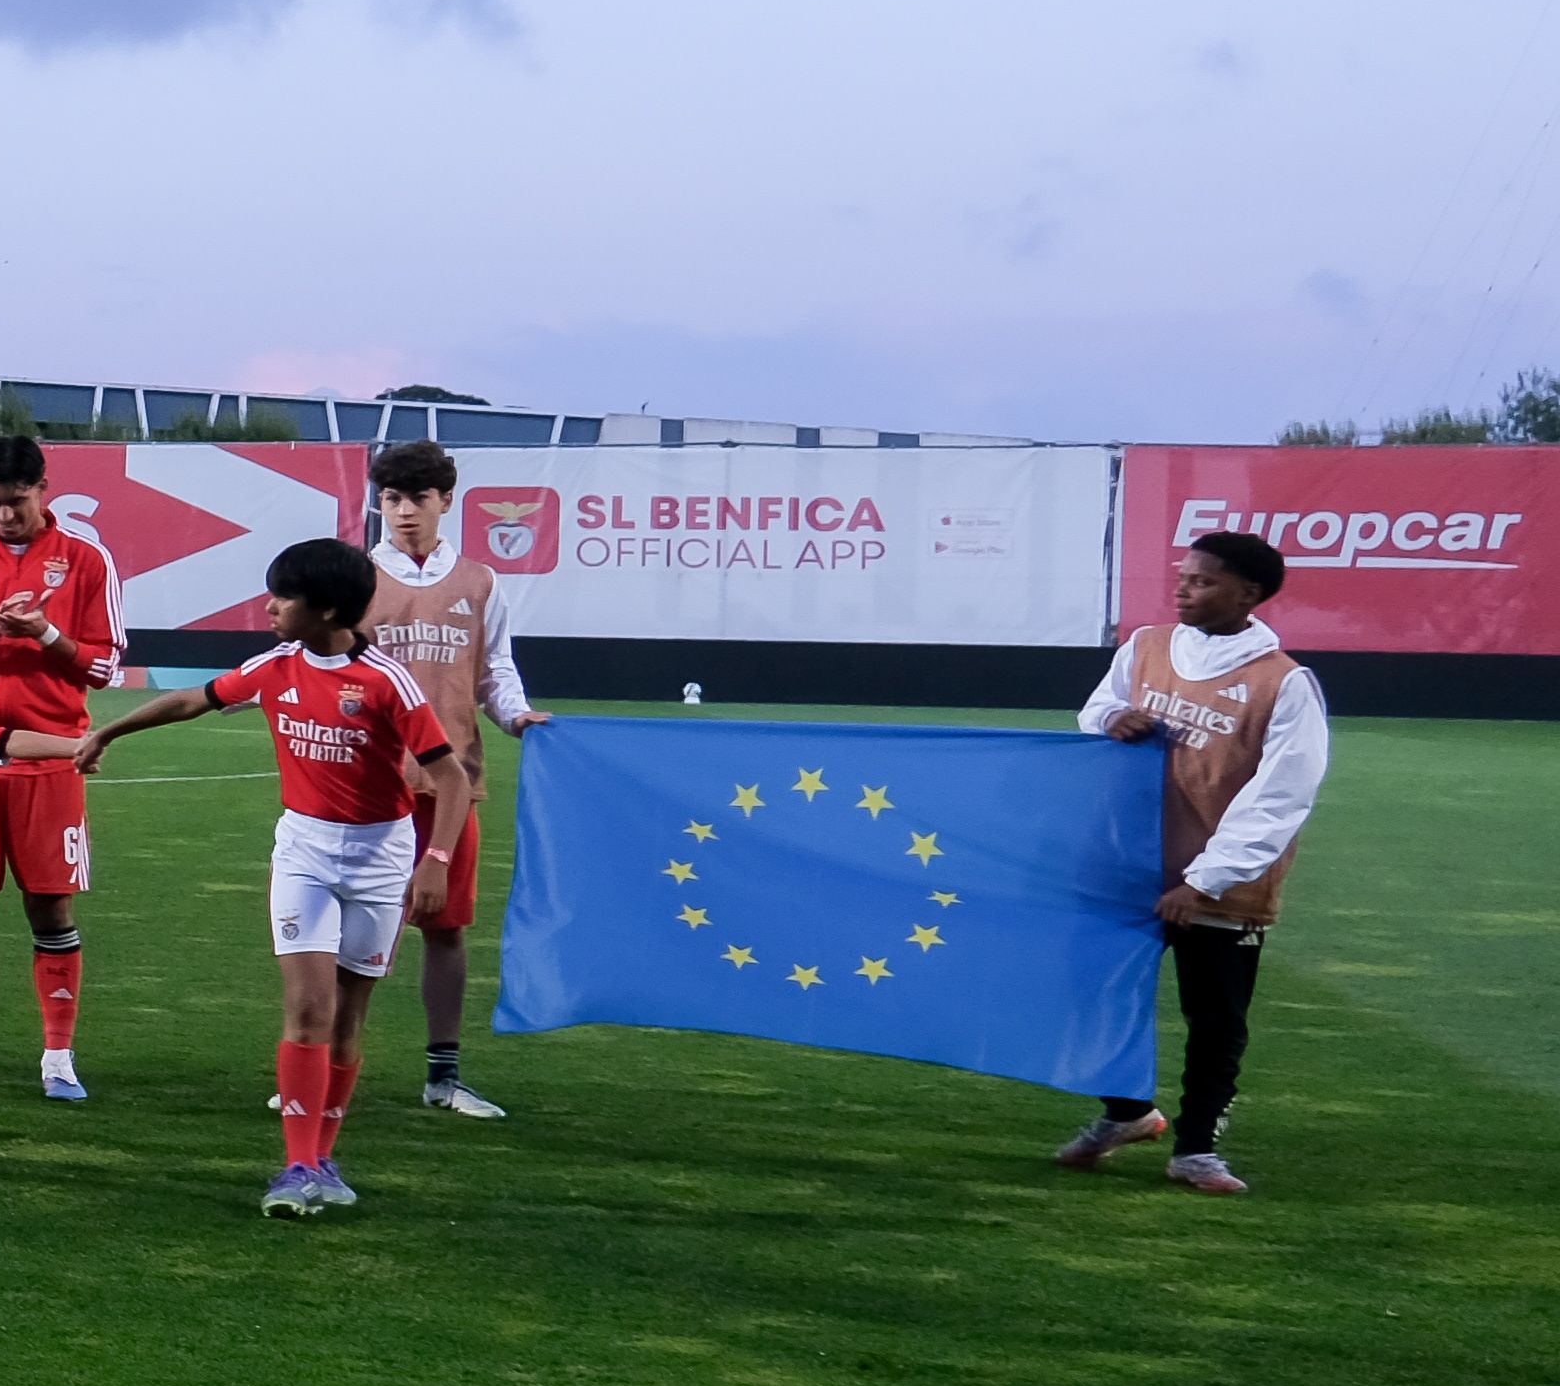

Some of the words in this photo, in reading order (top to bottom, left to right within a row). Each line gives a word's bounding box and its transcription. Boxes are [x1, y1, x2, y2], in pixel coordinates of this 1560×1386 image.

[576, 494, 636, 530] SL
[649, 495, 886, 532] BENFICA
[1171, 499, 1523, 568] Europcar
[576, 537, 783, 569] OFFICIAL
[794, 539, 886, 570] APP
[278, 713, 368, 746] Emirates
